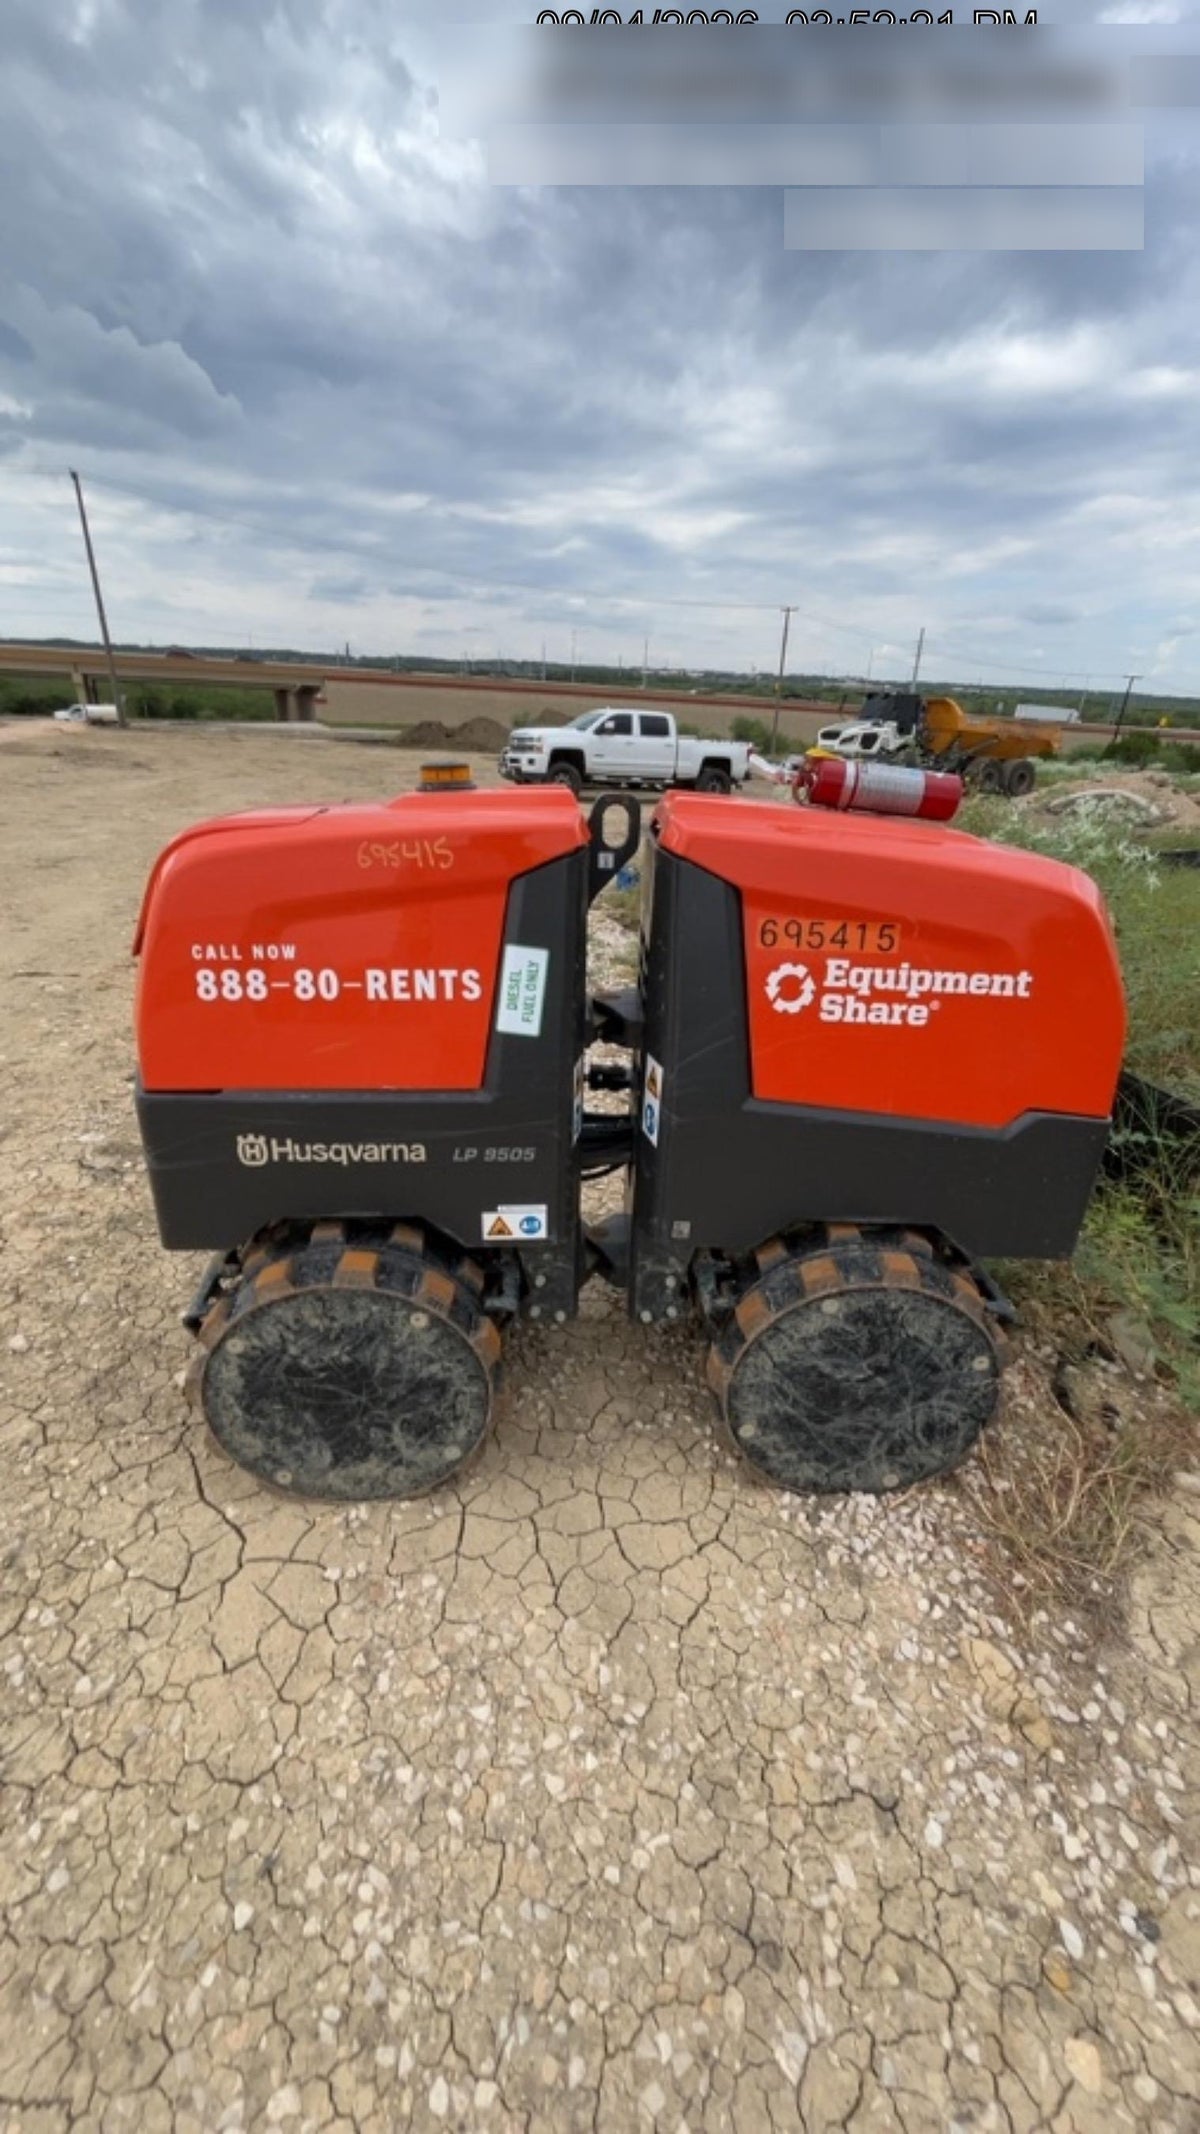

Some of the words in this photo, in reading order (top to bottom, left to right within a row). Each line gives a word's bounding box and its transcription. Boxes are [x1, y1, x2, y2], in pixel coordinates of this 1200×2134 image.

[357, 836, 454, 869] 695415
[760, 919, 897, 951] 695415
[191, 944, 242, 960] CALL
[252, 944, 296, 960] NOW
[195, 968, 482, 1000] 888-80-RENTS
[506, 969, 522, 1011] DIESEL
[525, 960, 540, 991] ONLY
[822, 958, 1033, 997] Equipment
[522, 994, 537, 1023] FUEL
[270, 1138, 426, 1165] Husqvarna
[452, 1148, 478, 1162] LP
[484, 1147, 536, 1162] 9505
